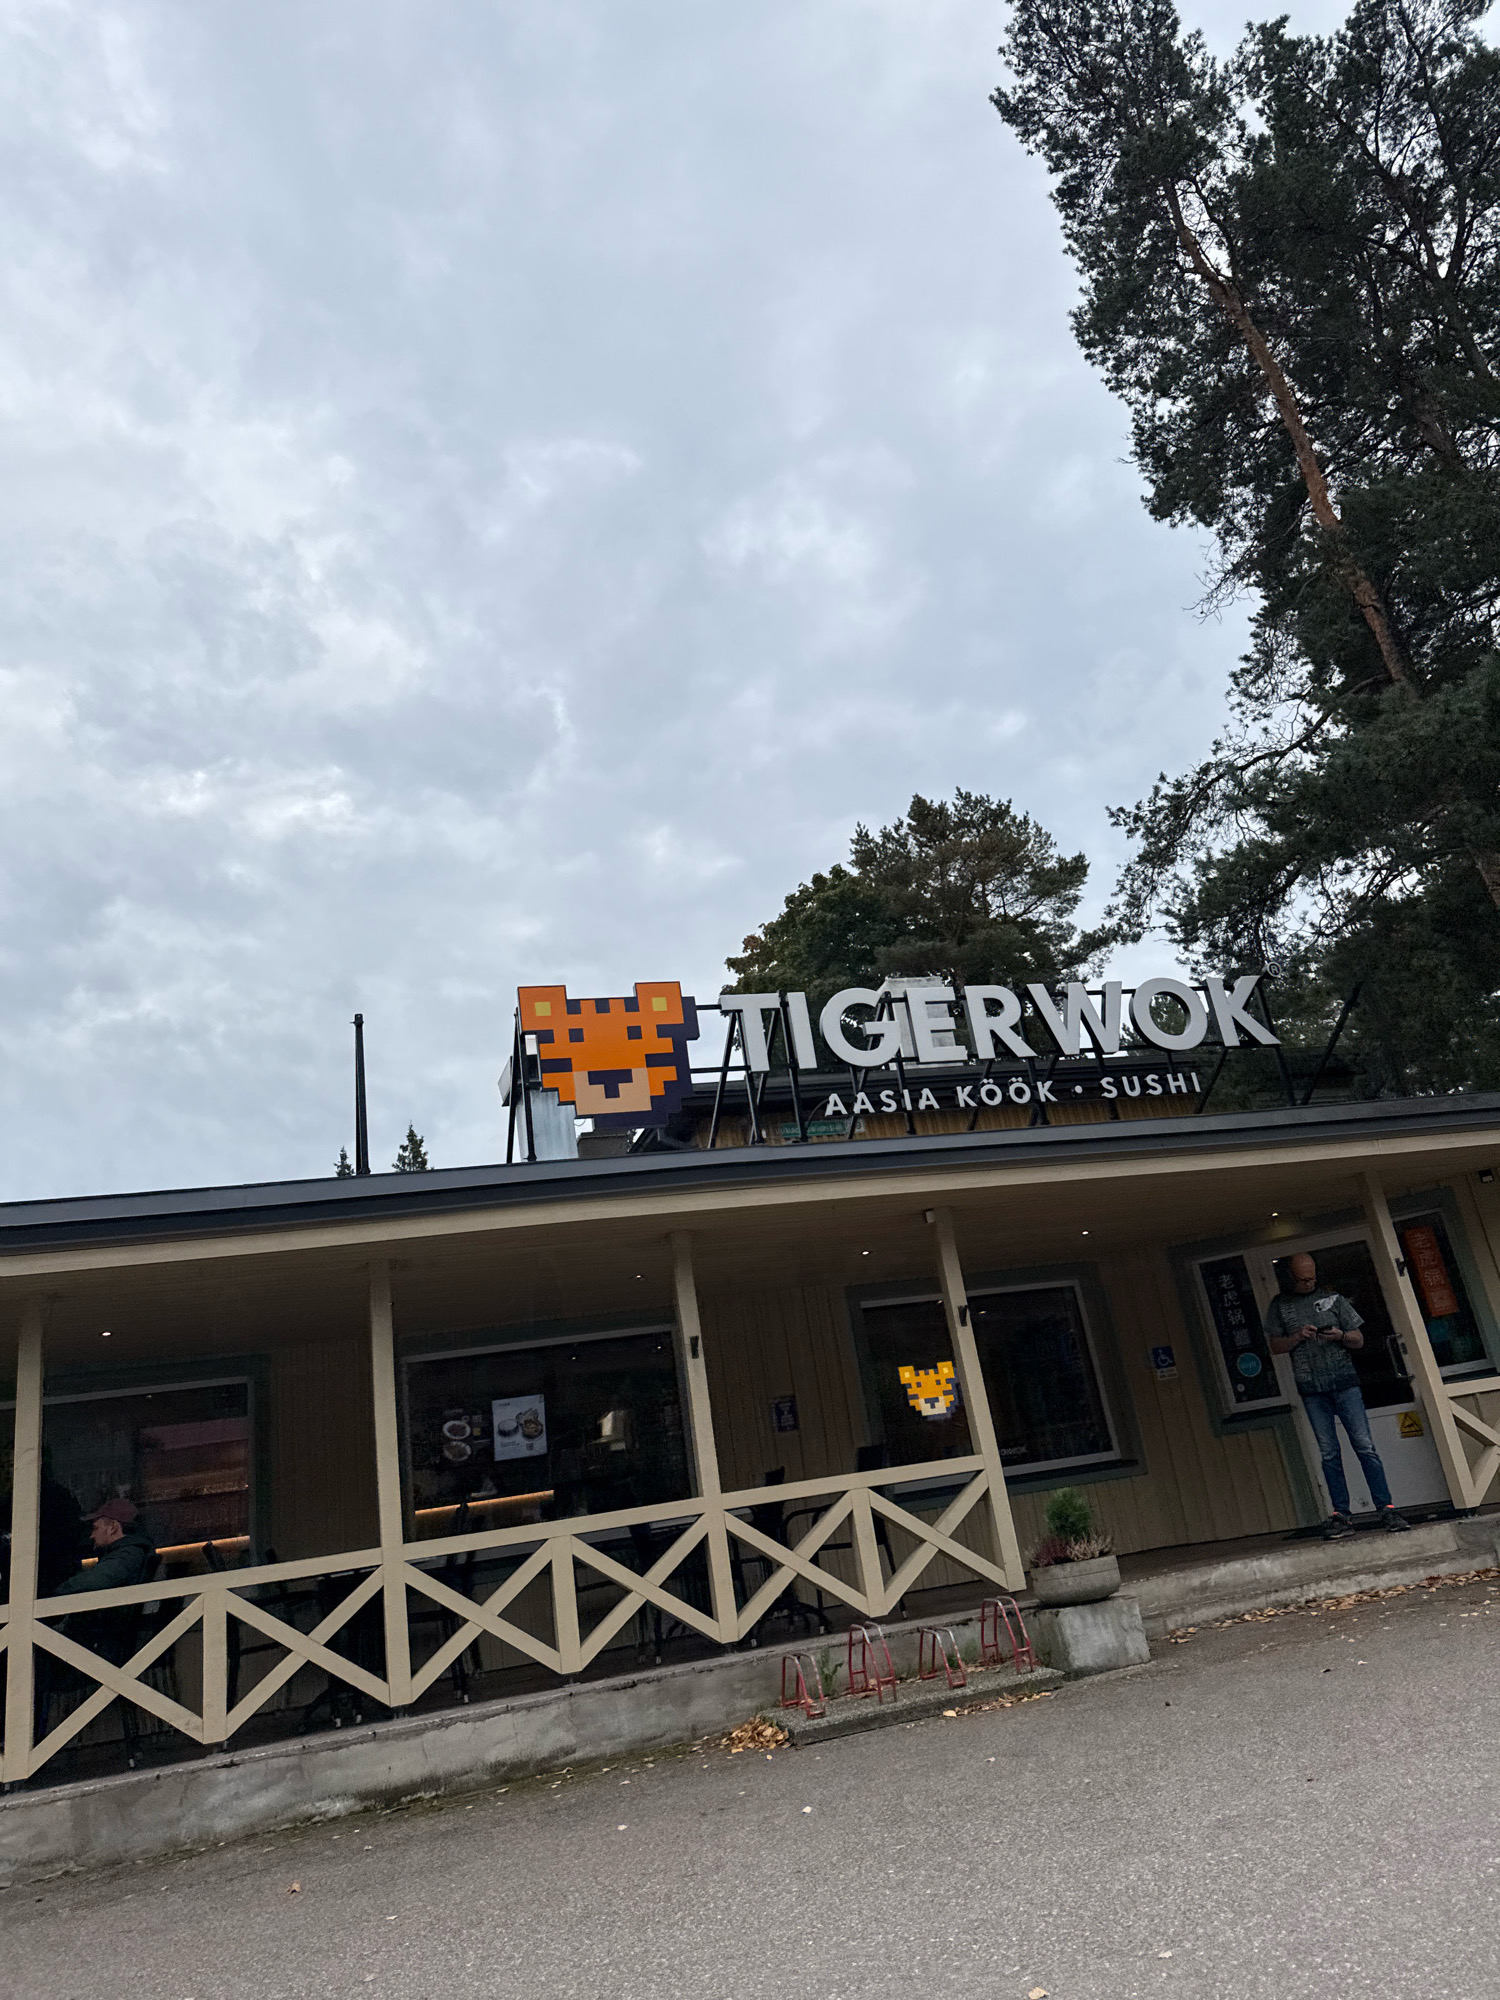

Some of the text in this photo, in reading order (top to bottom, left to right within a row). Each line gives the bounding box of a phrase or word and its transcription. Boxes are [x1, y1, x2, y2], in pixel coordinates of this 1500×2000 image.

[718, 974, 1281, 1072] TIGERWOK
[824, 1072, 1202, 1117] AASIA KÖÖK SUSHI
